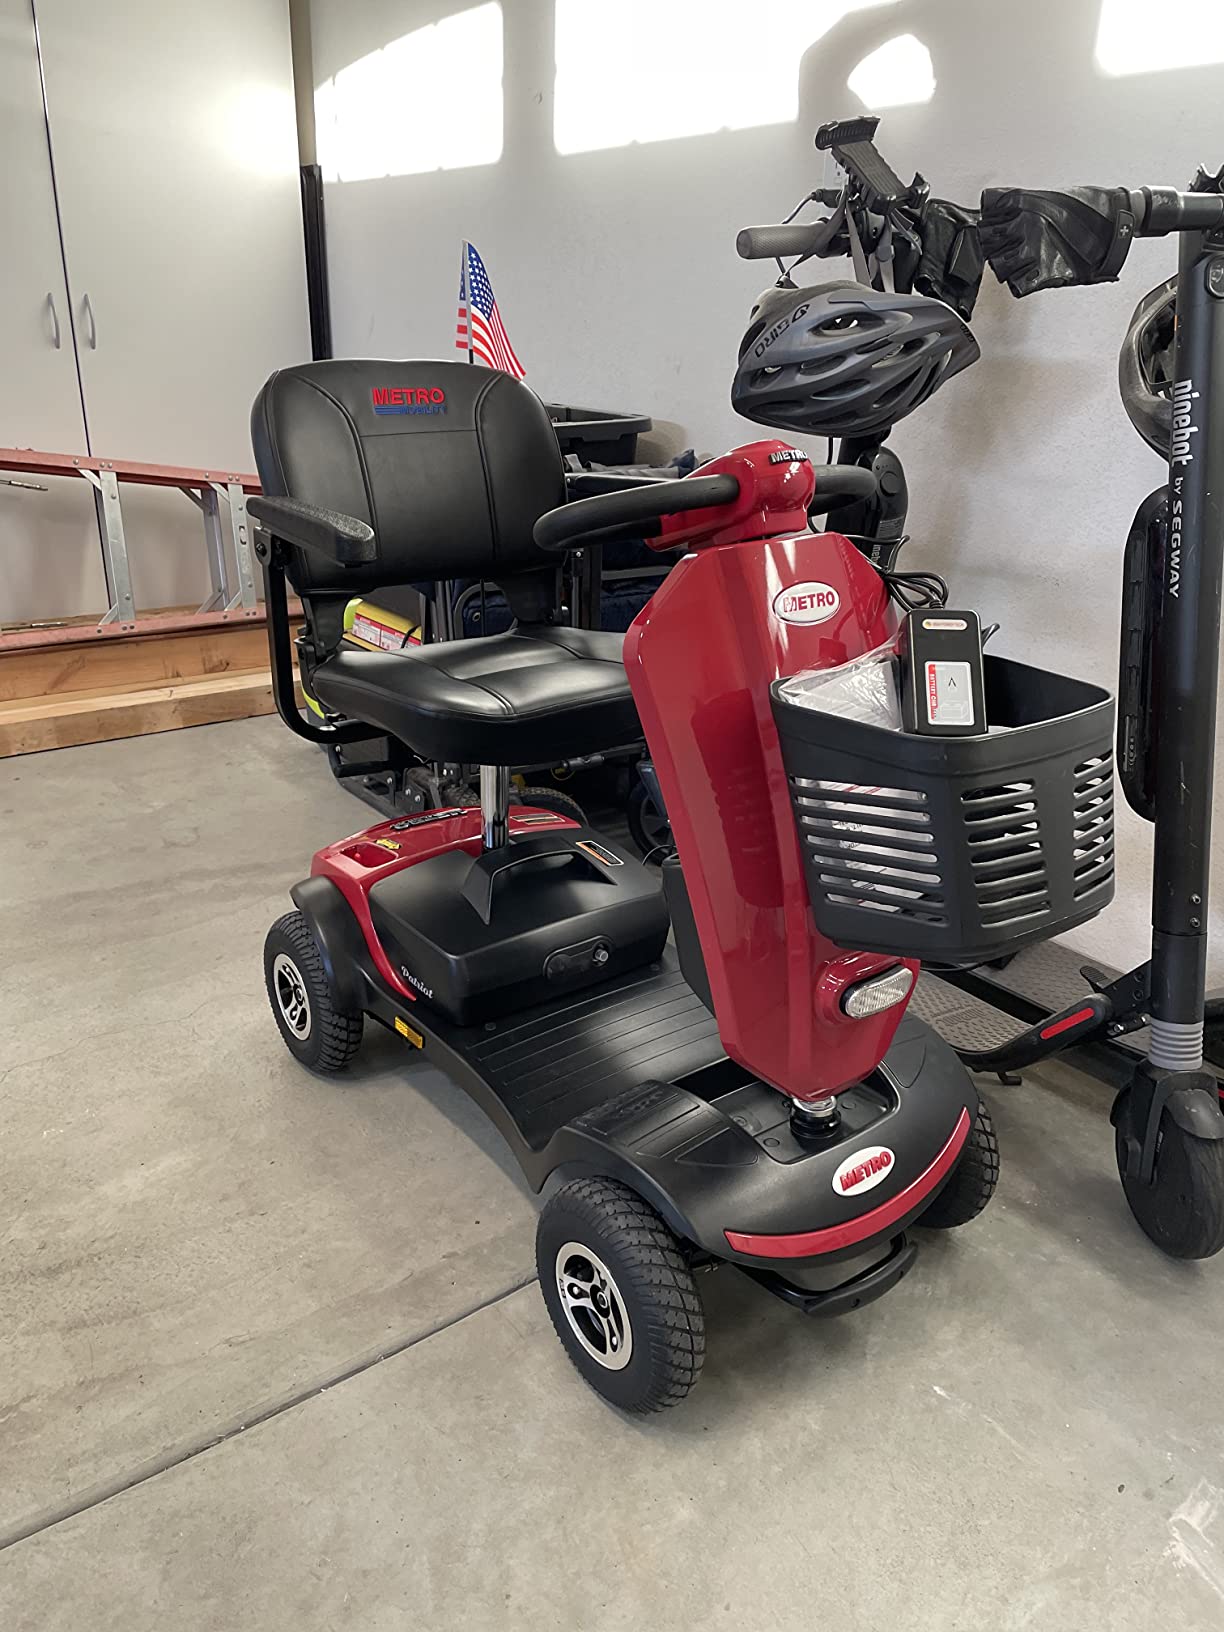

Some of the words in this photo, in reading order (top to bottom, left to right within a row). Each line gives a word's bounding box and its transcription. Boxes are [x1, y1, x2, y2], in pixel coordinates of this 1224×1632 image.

[754, 319, 790, 358] GIRO
[372, 387, 446, 405] METRO
[1171, 380, 1200, 467] ninebot
[1173, 476, 1183, 494] by
[1169, 500, 1183, 598] SEGWAY
[783, 591, 836, 612] METRO
[401, 965, 434, 999] Patriot
[840, 1151, 891, 1191] METRO
